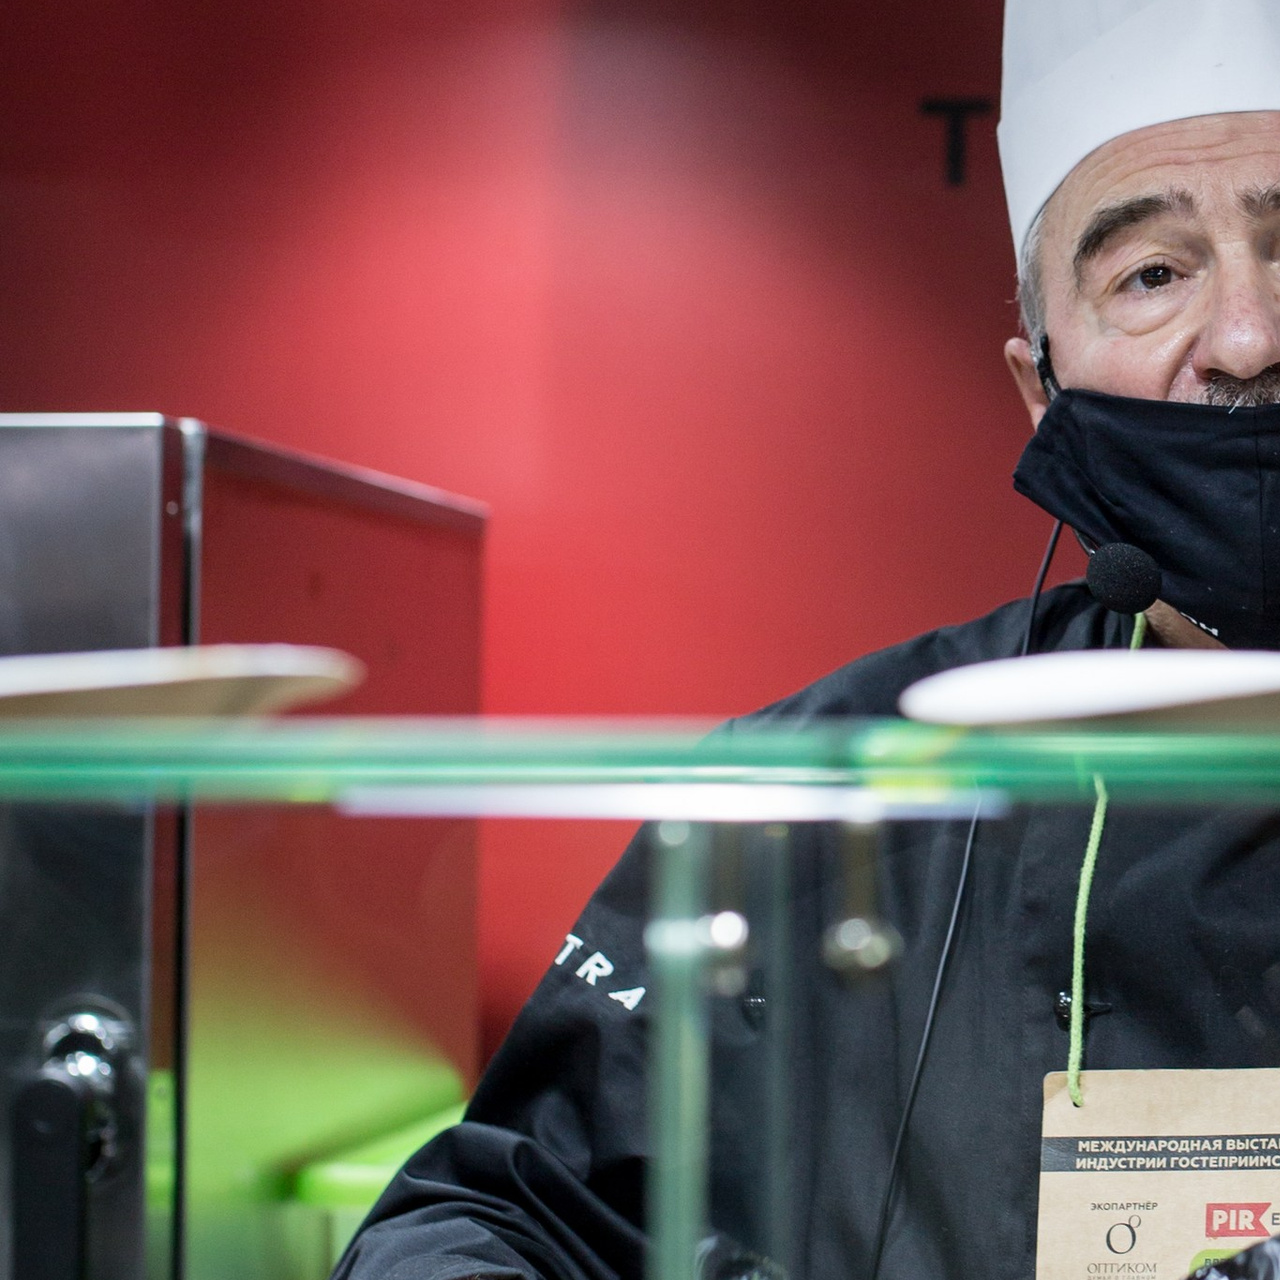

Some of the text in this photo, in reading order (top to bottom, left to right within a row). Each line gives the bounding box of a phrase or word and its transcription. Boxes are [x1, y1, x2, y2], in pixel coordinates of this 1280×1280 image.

[1077, 1138, 1222, 1154] МЕЖДУНАРОДНАЯ
[1075, 1156, 1167, 1171] ИНДУСТРИИ
[1212, 1209, 1255, 1231] PIR
[1086, 1262, 1158, 1274] ОПТИКОМ
